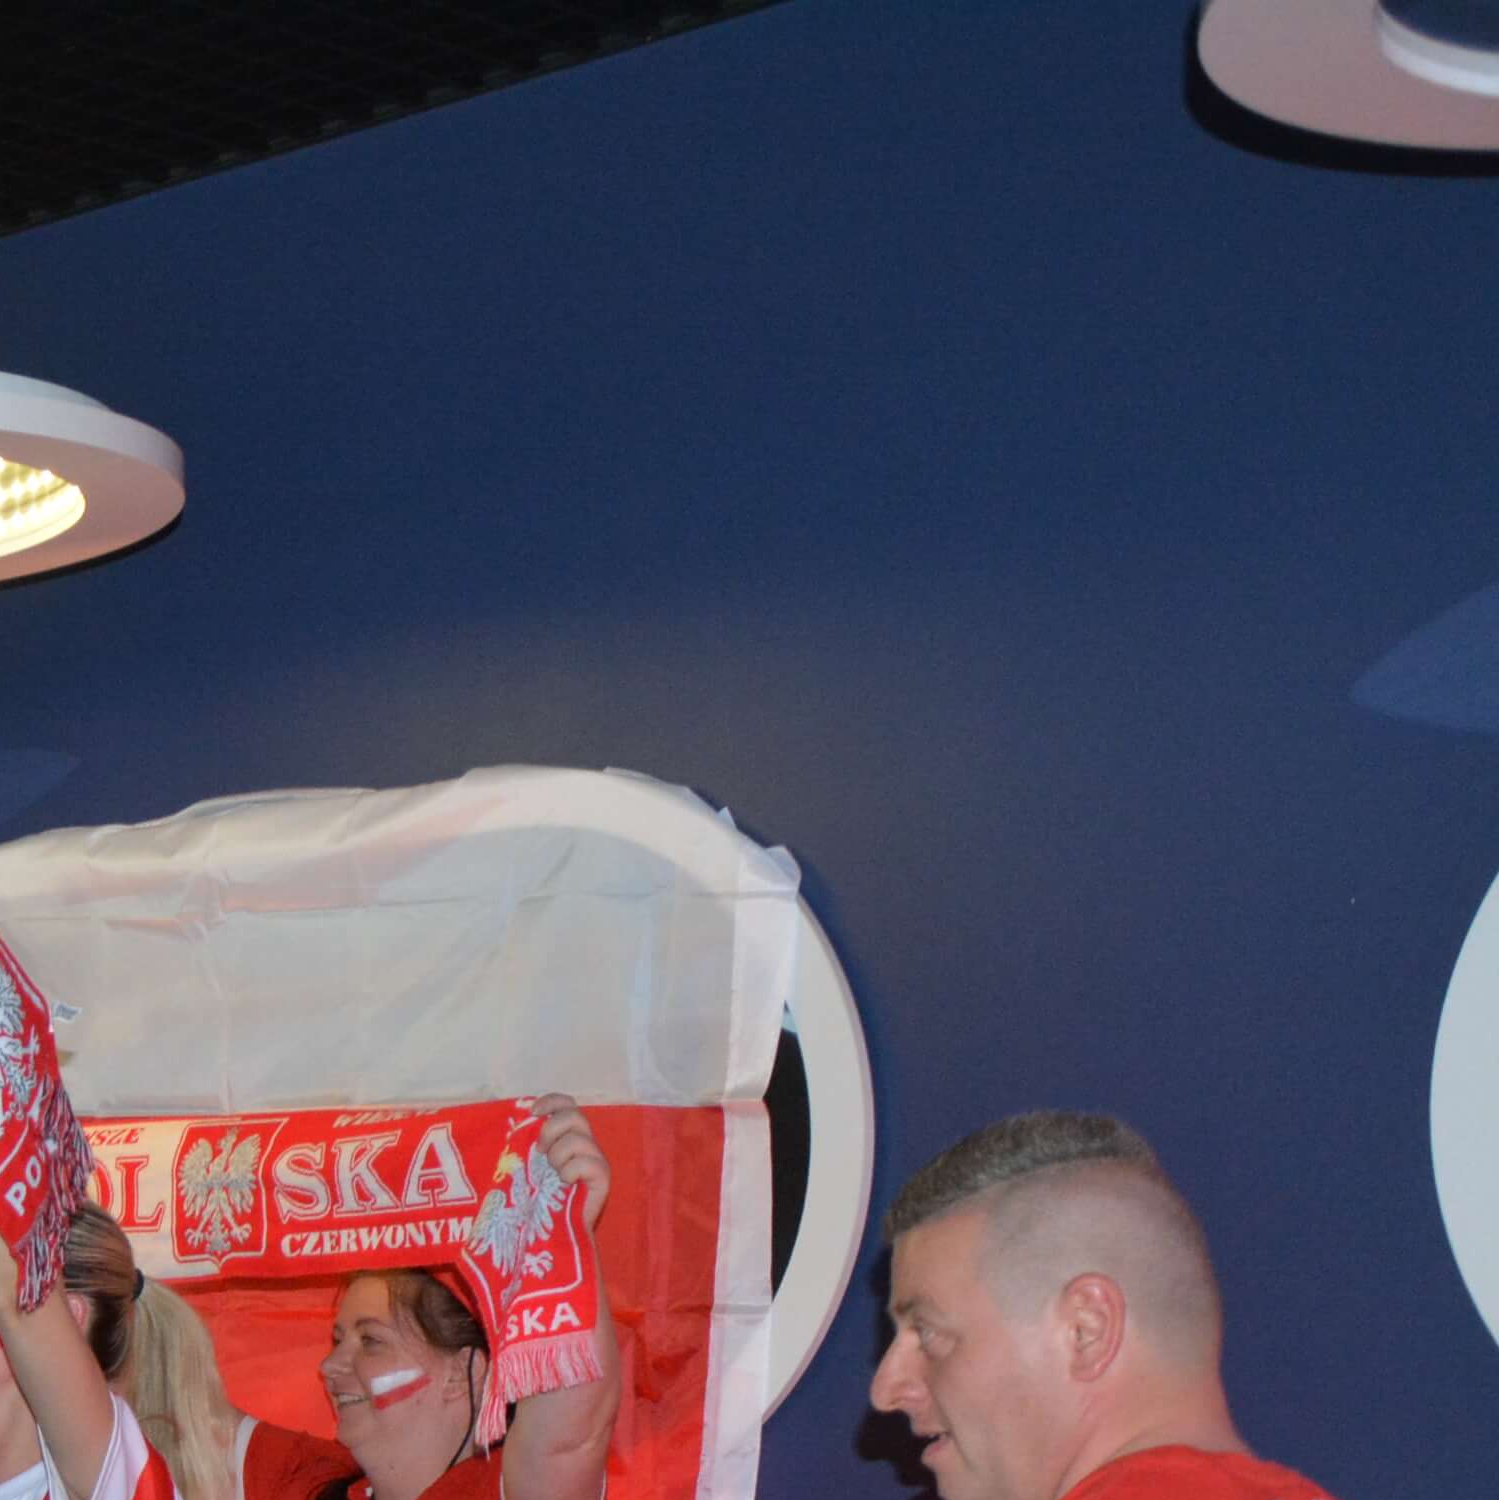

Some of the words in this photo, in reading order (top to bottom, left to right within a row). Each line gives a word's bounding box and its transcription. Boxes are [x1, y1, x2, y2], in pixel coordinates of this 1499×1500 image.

[275, 1122, 477, 1225] SKA
[281, 1216, 473, 1259] CZERWONYM
[505, 1302, 580, 1342] SKA
